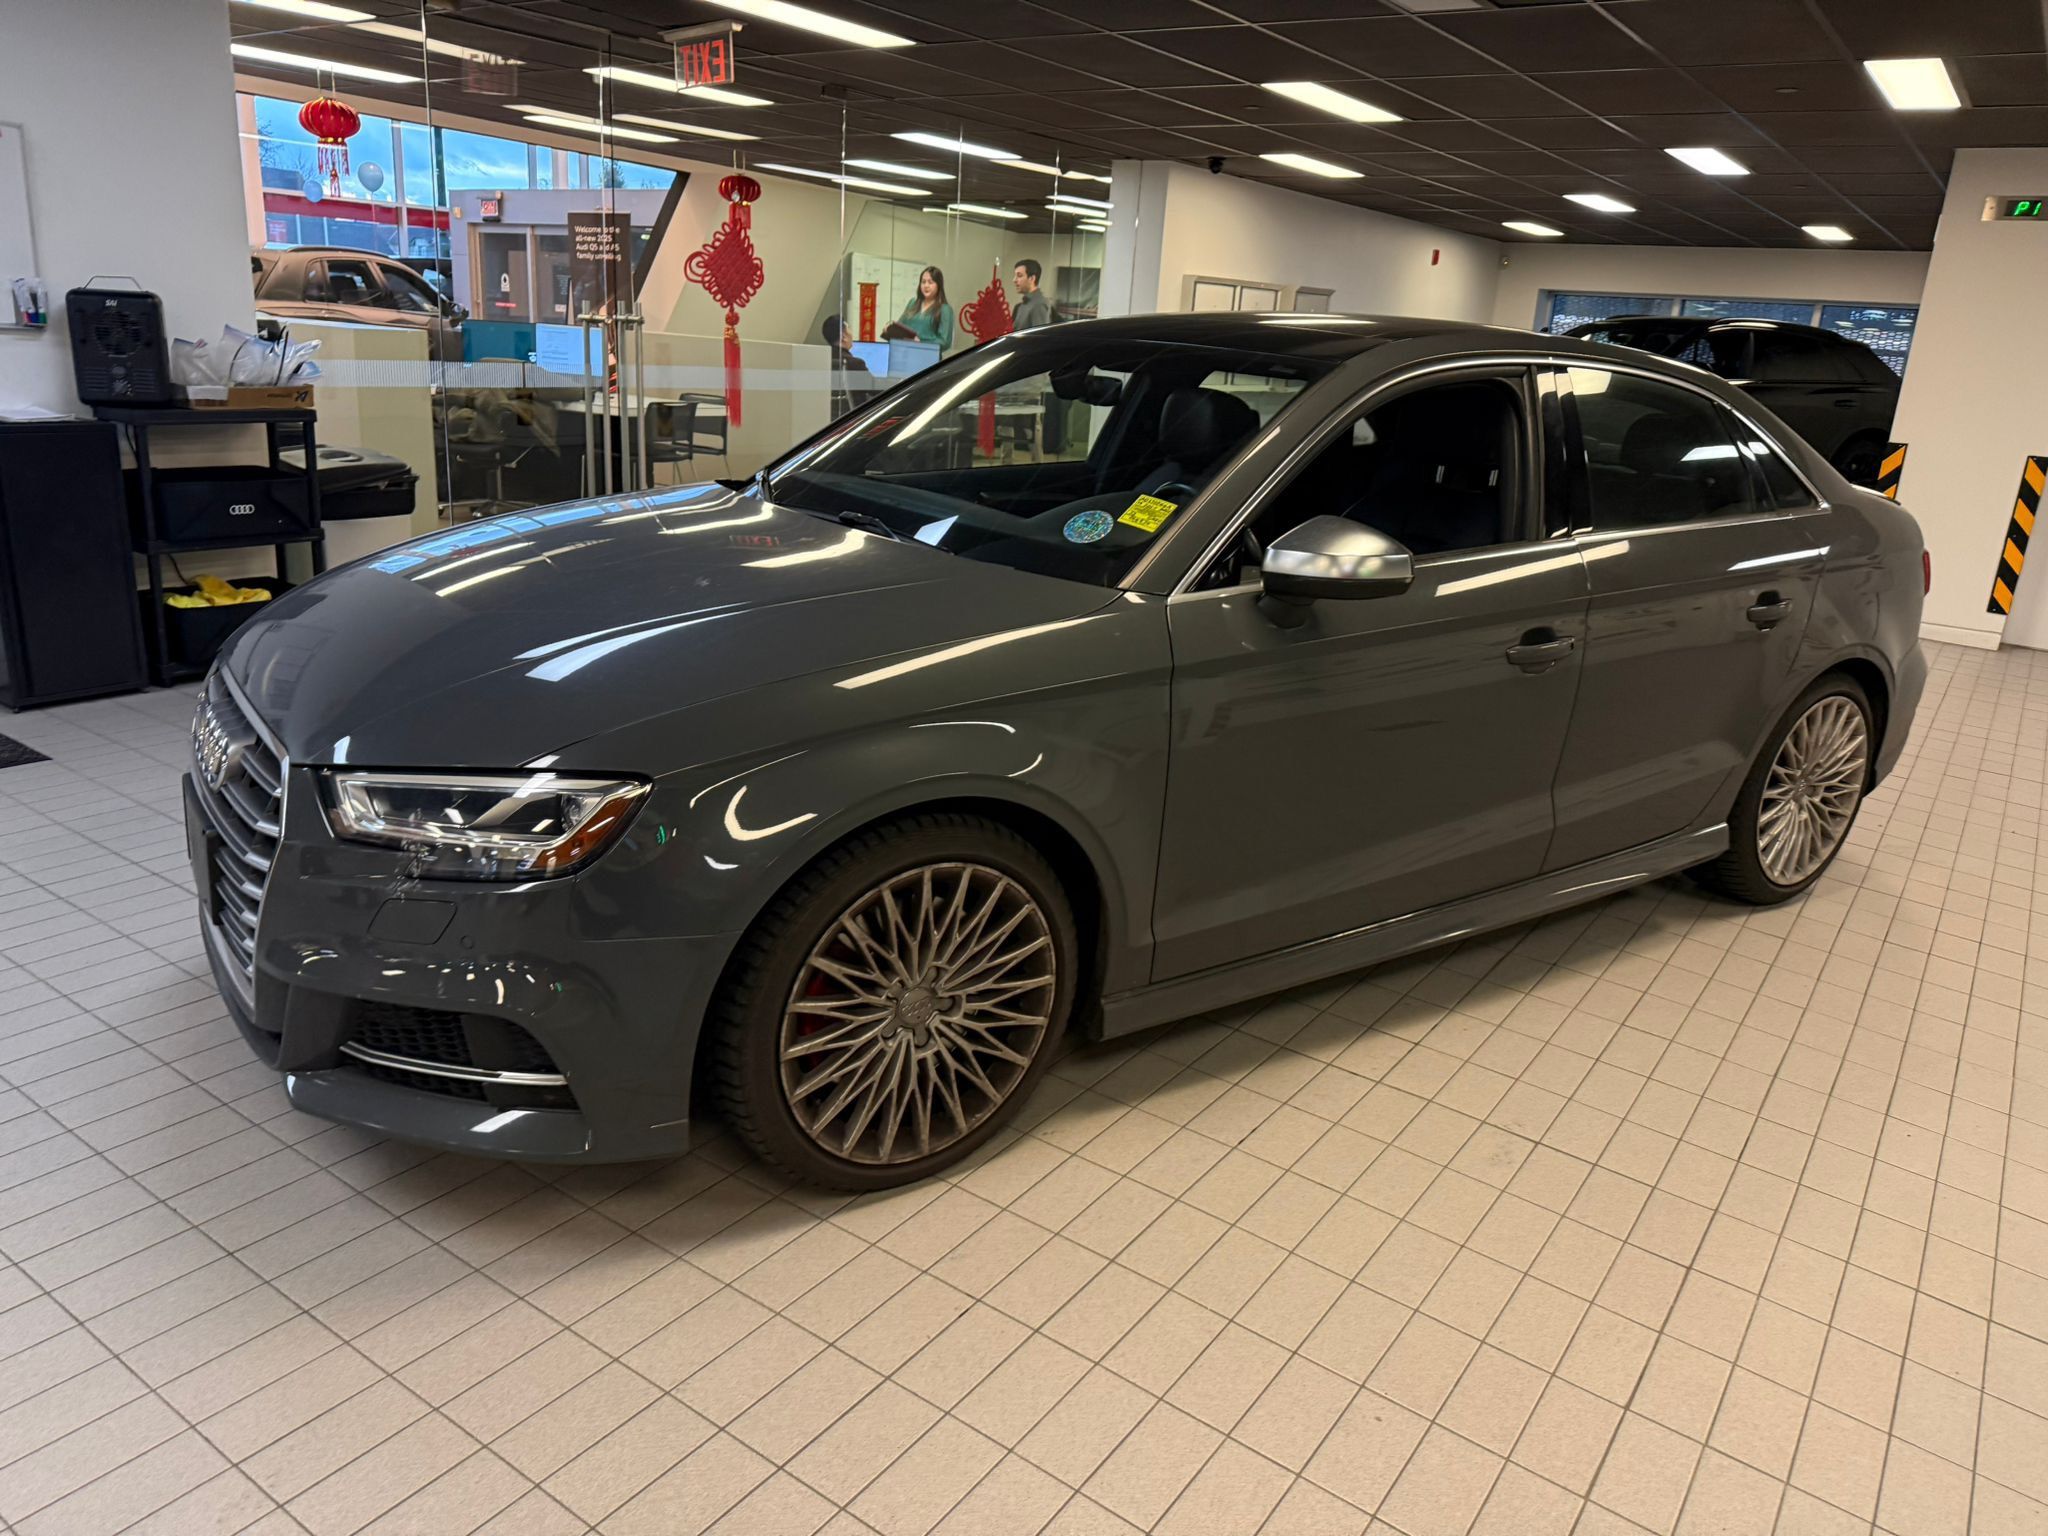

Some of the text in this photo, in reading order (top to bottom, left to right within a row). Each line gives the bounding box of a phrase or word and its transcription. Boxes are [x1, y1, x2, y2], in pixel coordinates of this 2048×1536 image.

[575, 225, 602, 233] Welcome
[575, 234, 597, 242] all-new
[576, 242, 588, 250] Audi
[576, 251, 622, 262] family unveilig
